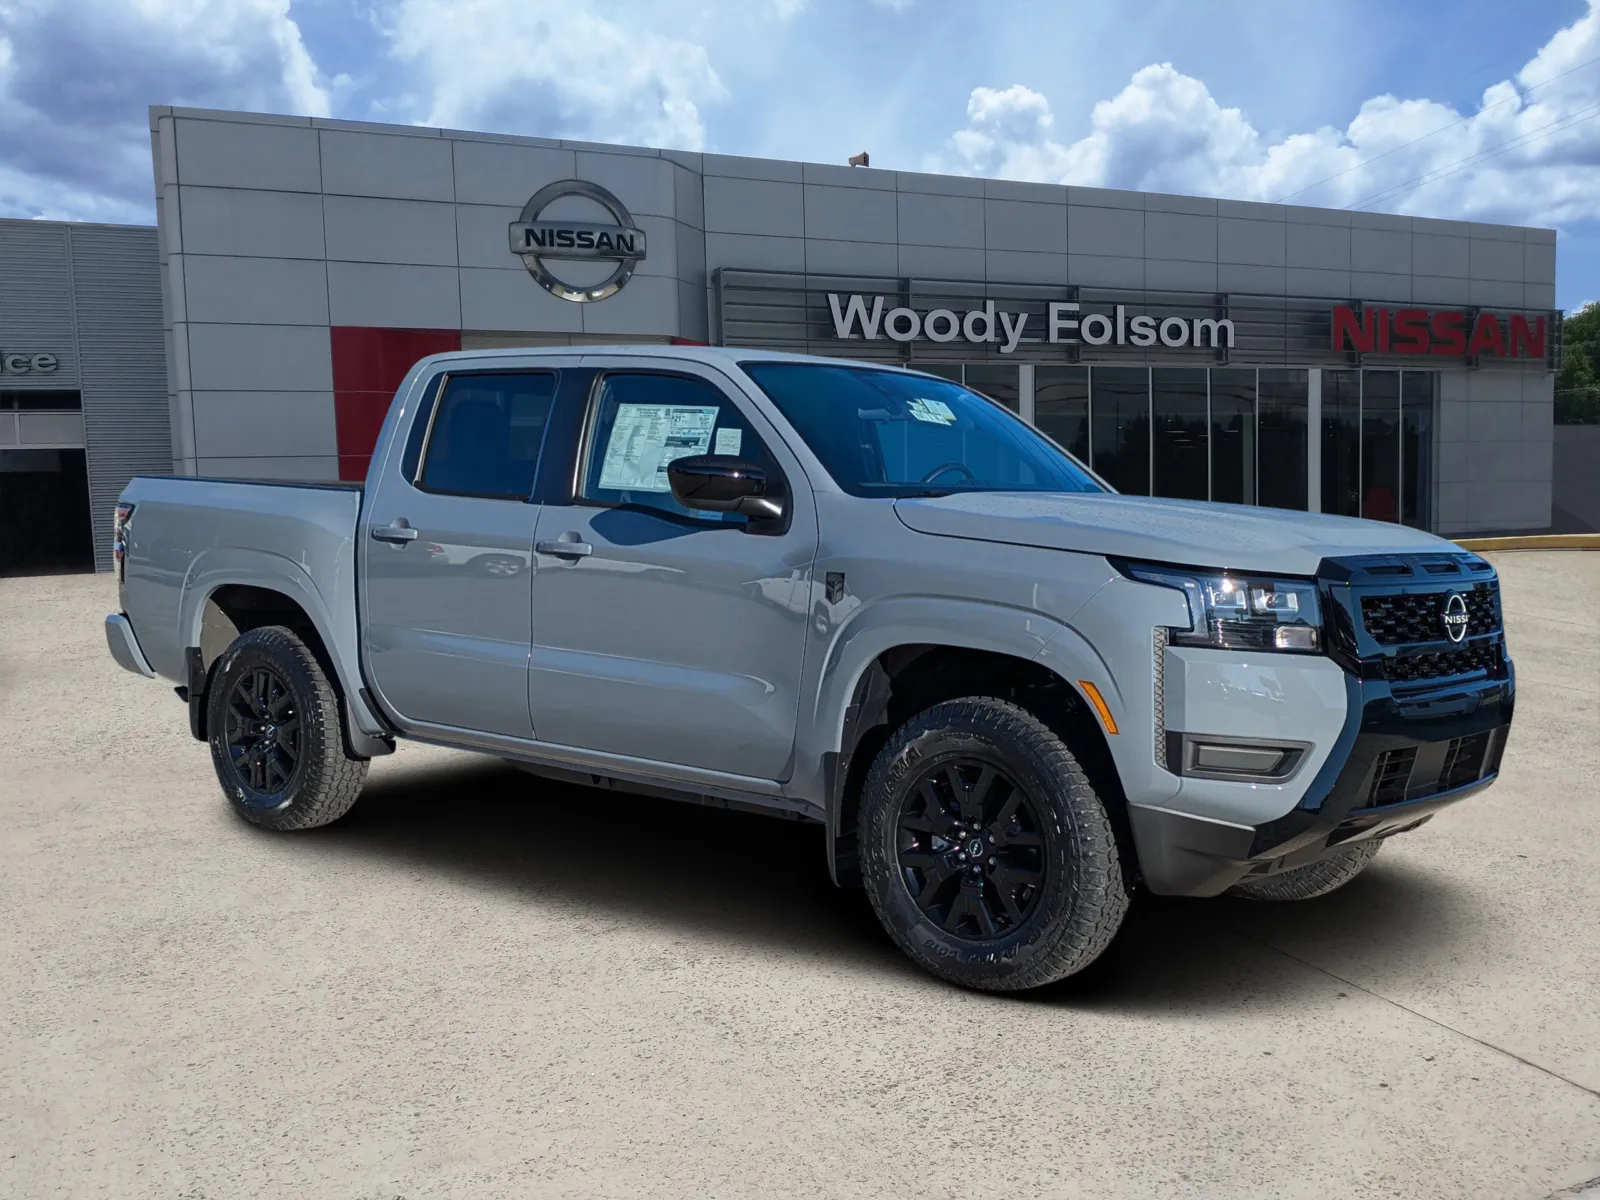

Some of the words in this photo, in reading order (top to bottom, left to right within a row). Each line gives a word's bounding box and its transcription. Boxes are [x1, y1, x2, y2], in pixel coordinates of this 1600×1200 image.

[525, 227, 635, 252] NISSAN
[827, 293, 1028, 353] Woody
[1048, 302, 1235, 348] Folsom
[1333, 304, 1546, 358] NISSAN
